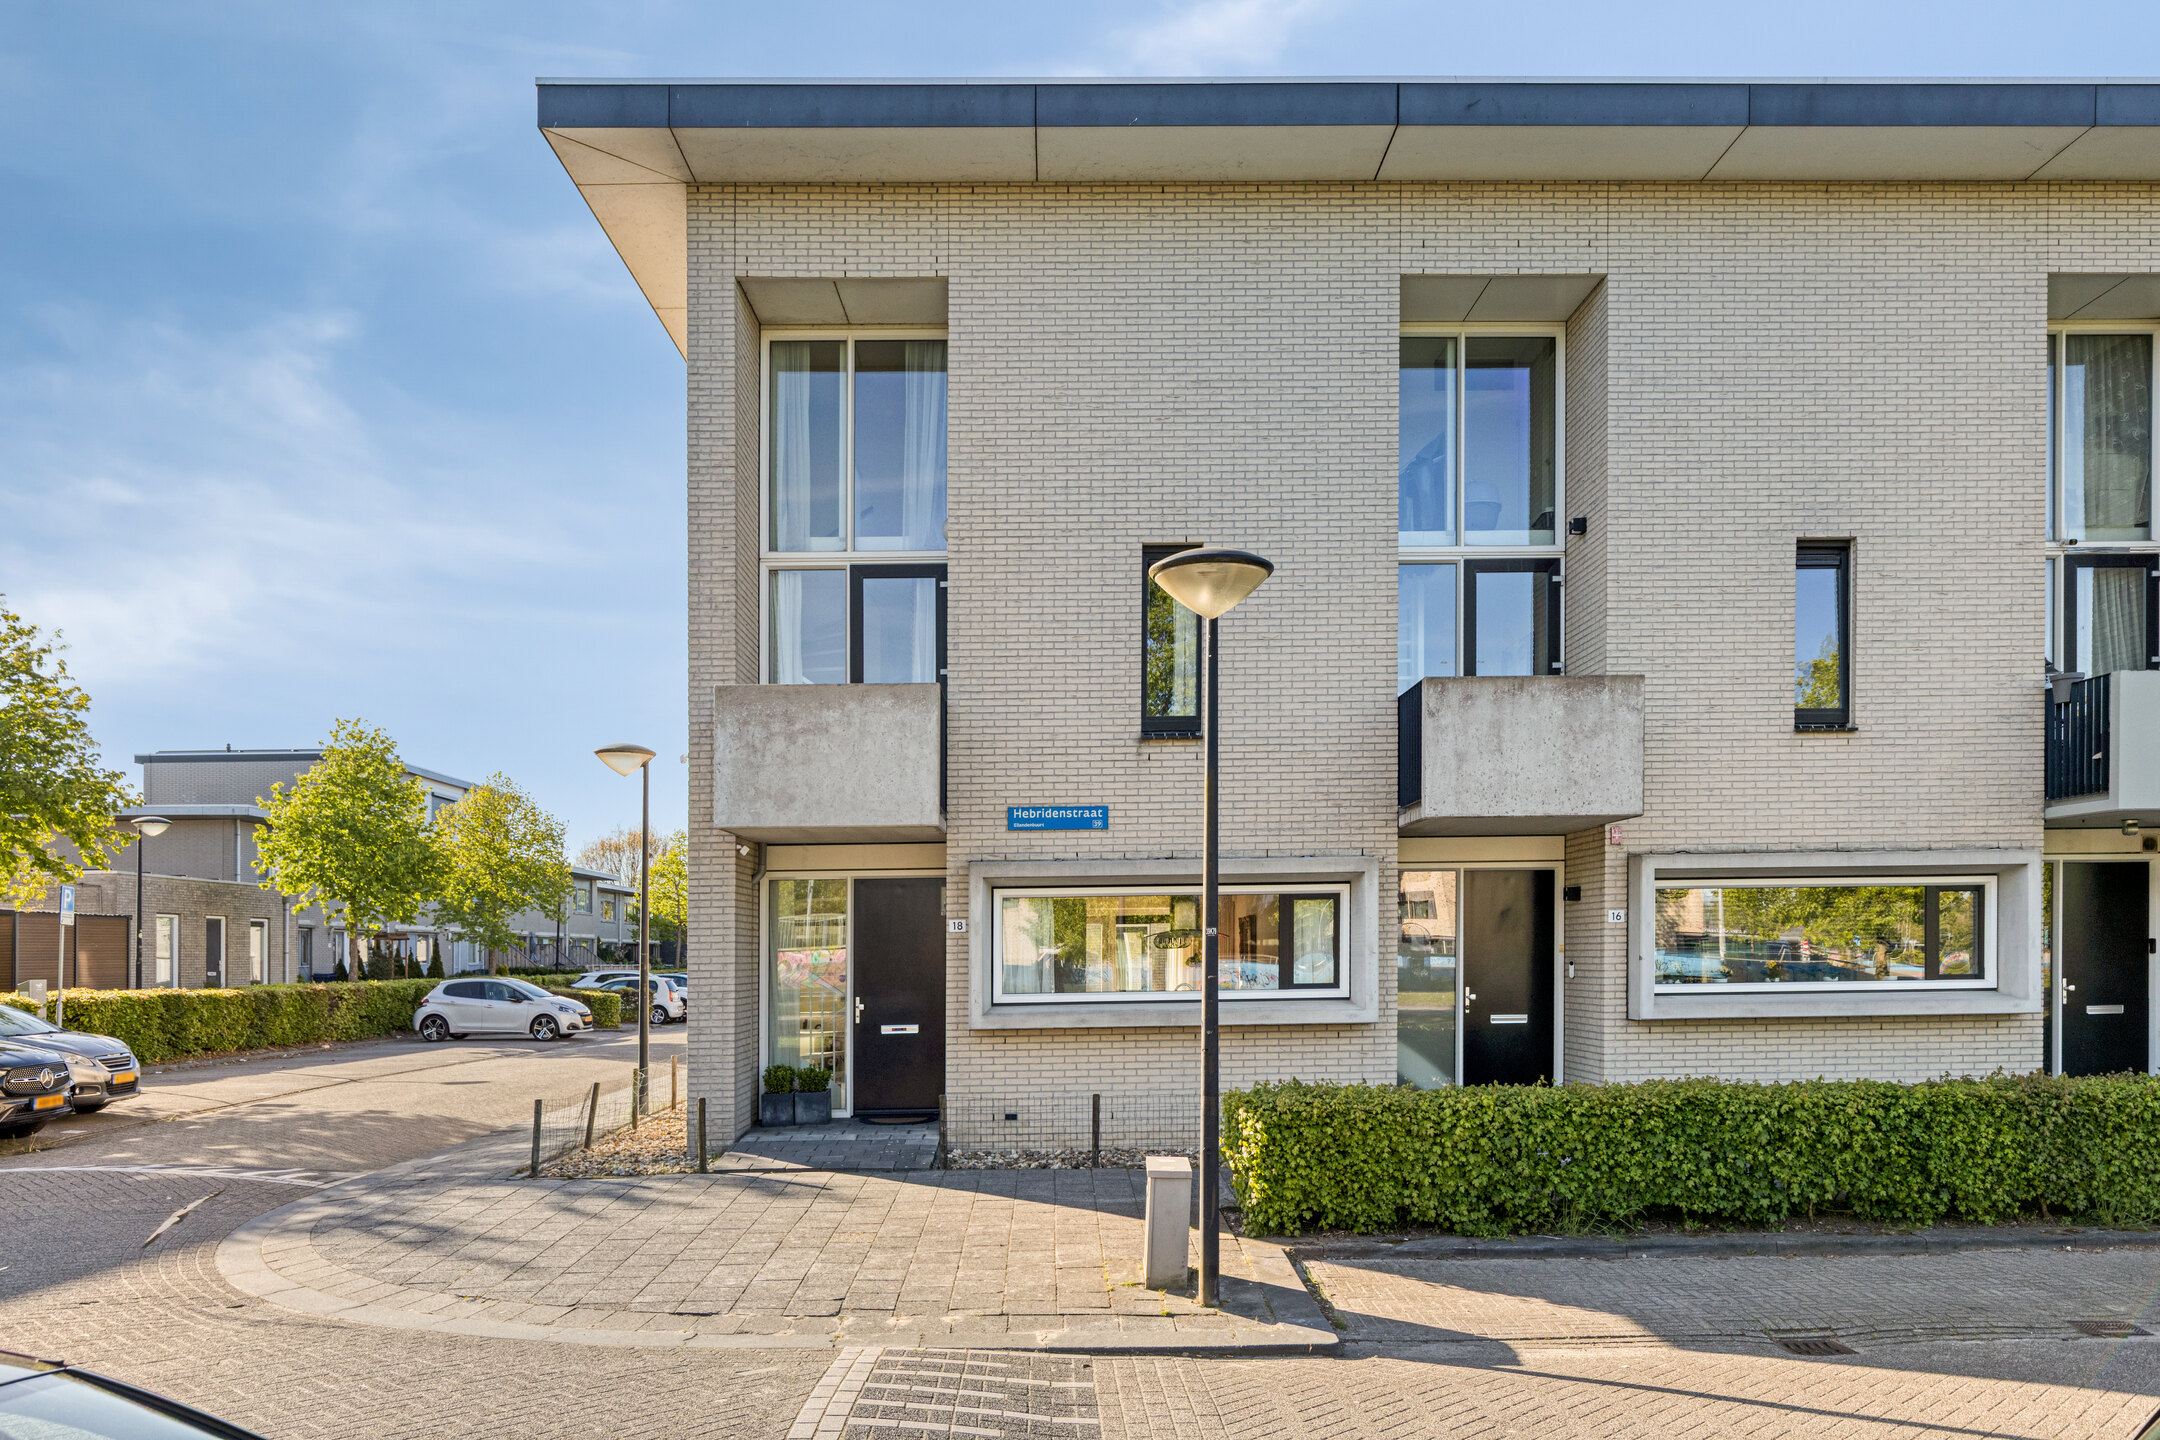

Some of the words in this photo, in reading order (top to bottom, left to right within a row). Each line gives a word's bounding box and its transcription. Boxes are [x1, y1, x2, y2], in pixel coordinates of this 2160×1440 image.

[1013, 808, 1103, 819] Hebridenstraat
[64, 889, 72, 909] P
[1611, 911, 1622, 921] 16
[952, 921, 963, 931] 18
